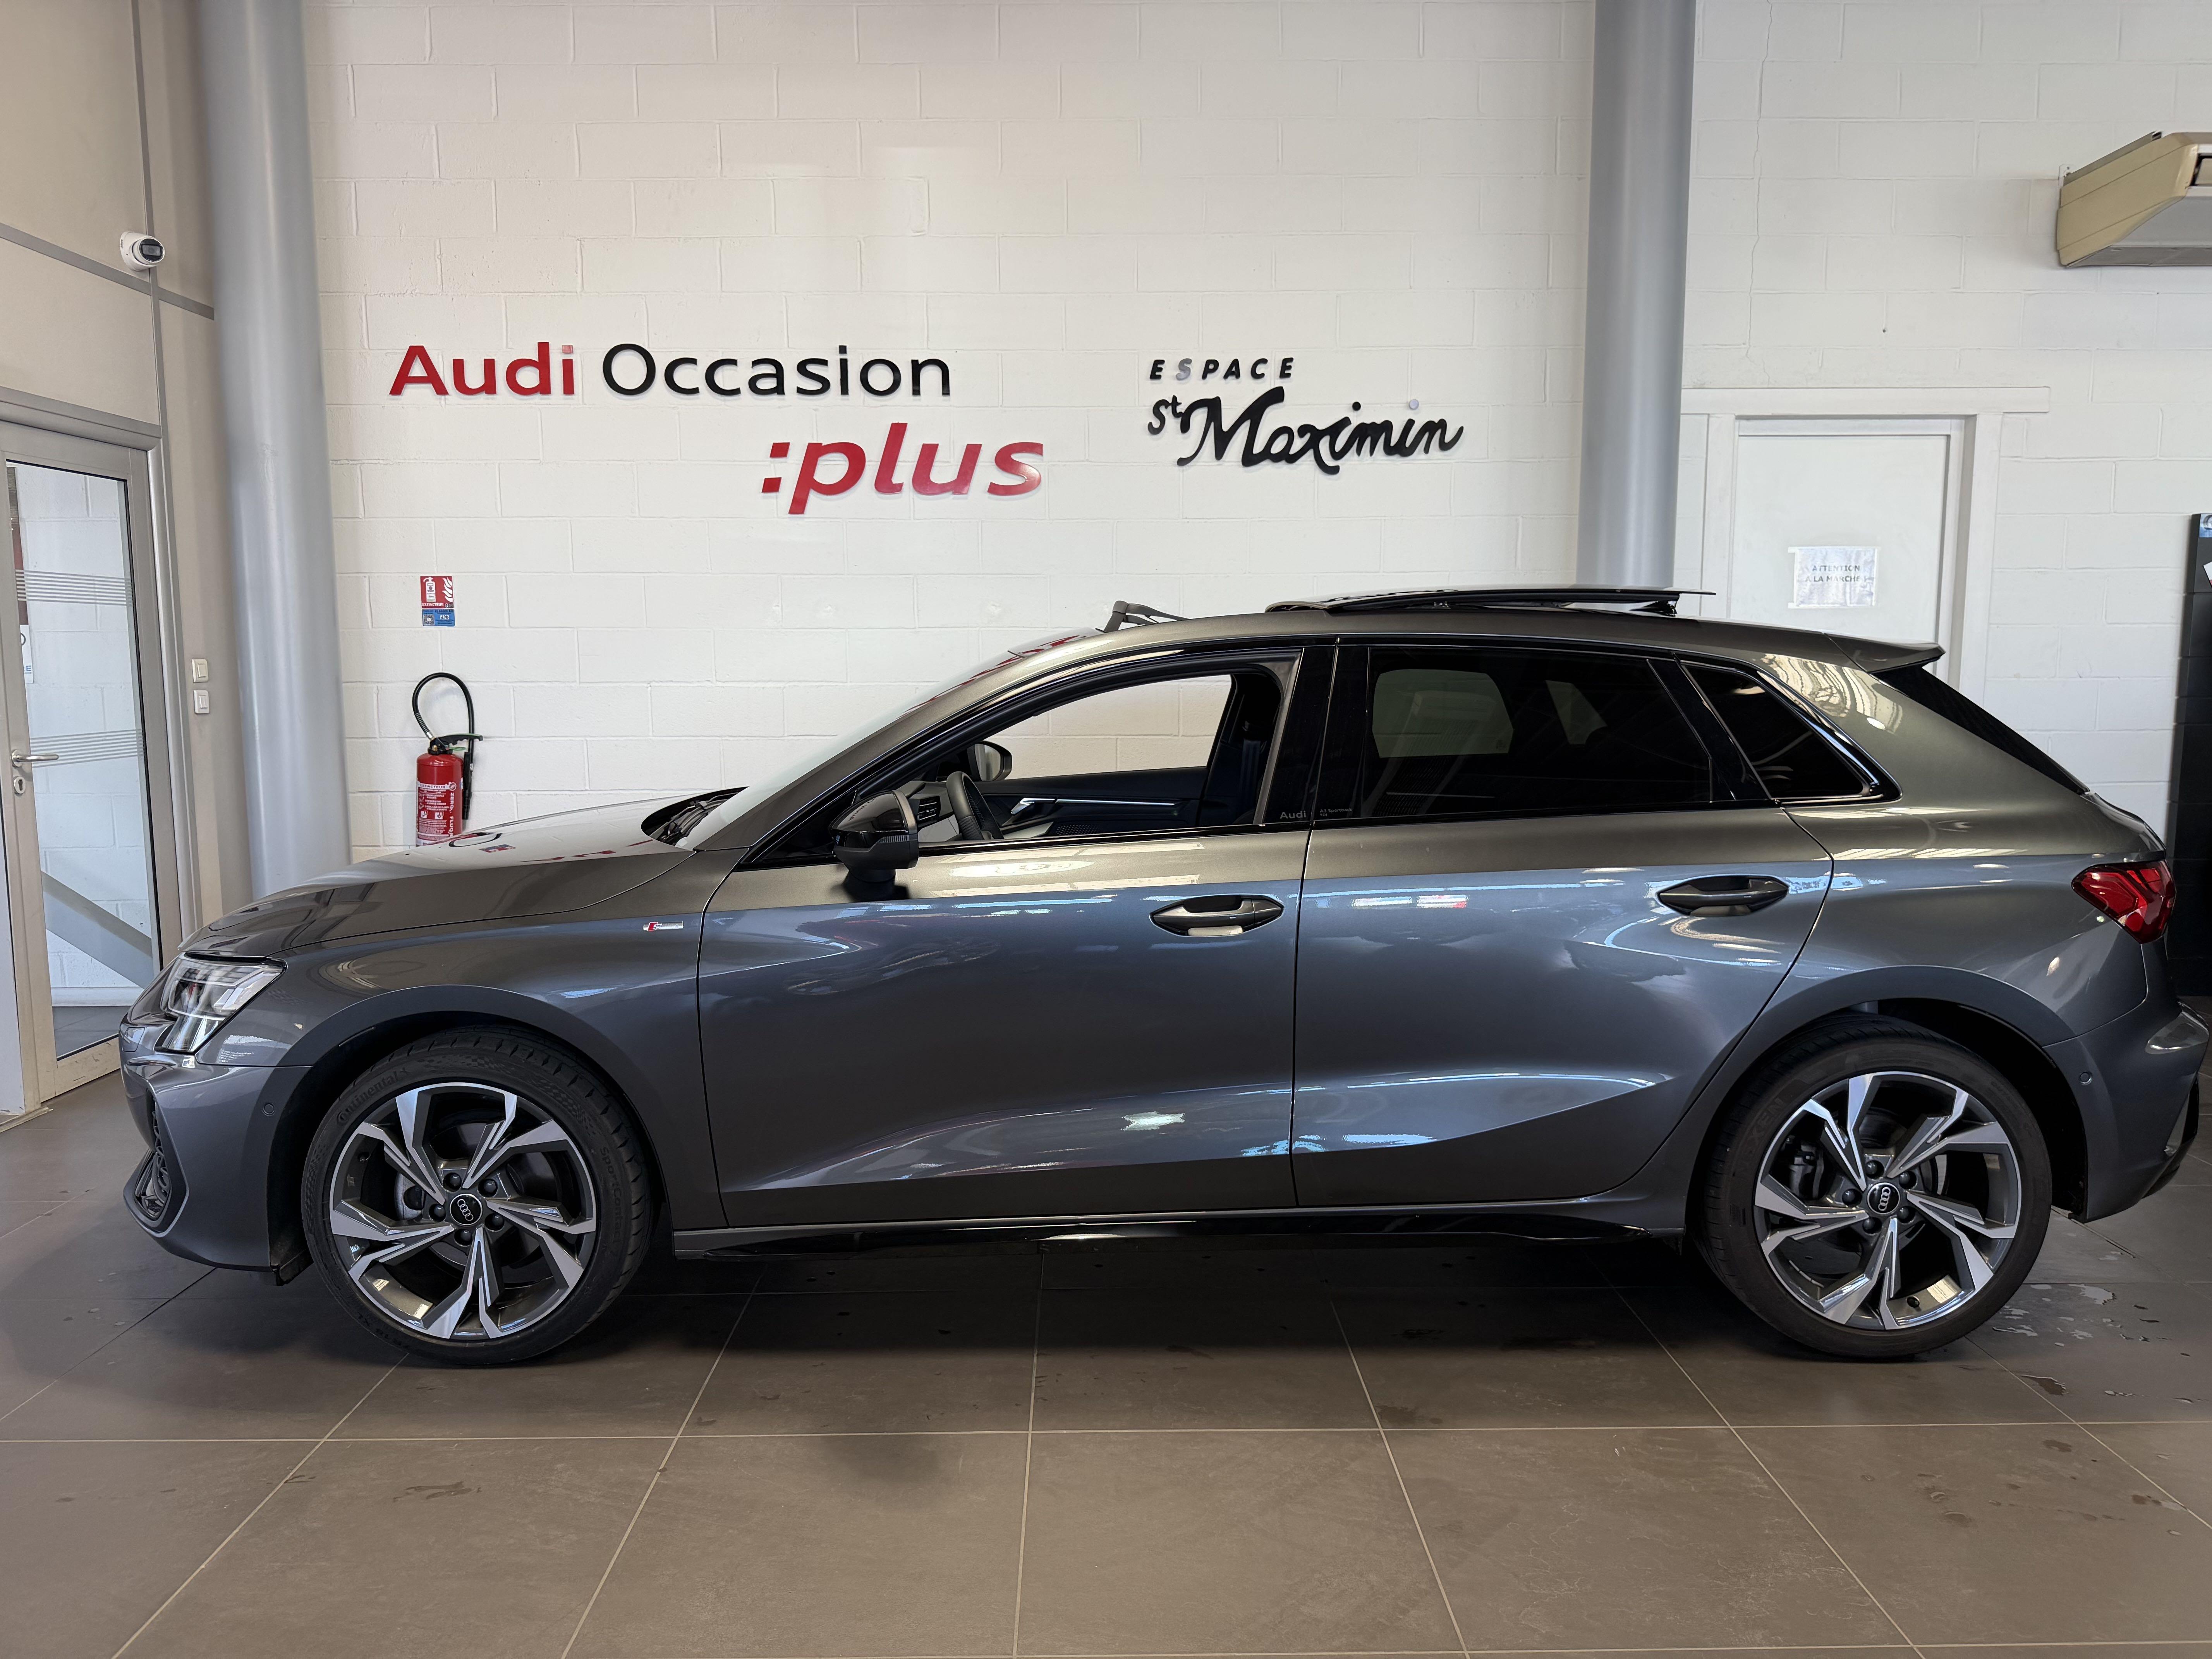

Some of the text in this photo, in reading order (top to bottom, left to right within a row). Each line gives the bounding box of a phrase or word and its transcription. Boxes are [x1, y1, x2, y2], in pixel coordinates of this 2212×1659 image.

[390, 342, 950, 396] Audi Occasion
[1149, 357, 1294, 381] ESPACE
[1147, 386, 1464, 475] St Maximin
[1279, 810, 1306, 819] Audi
